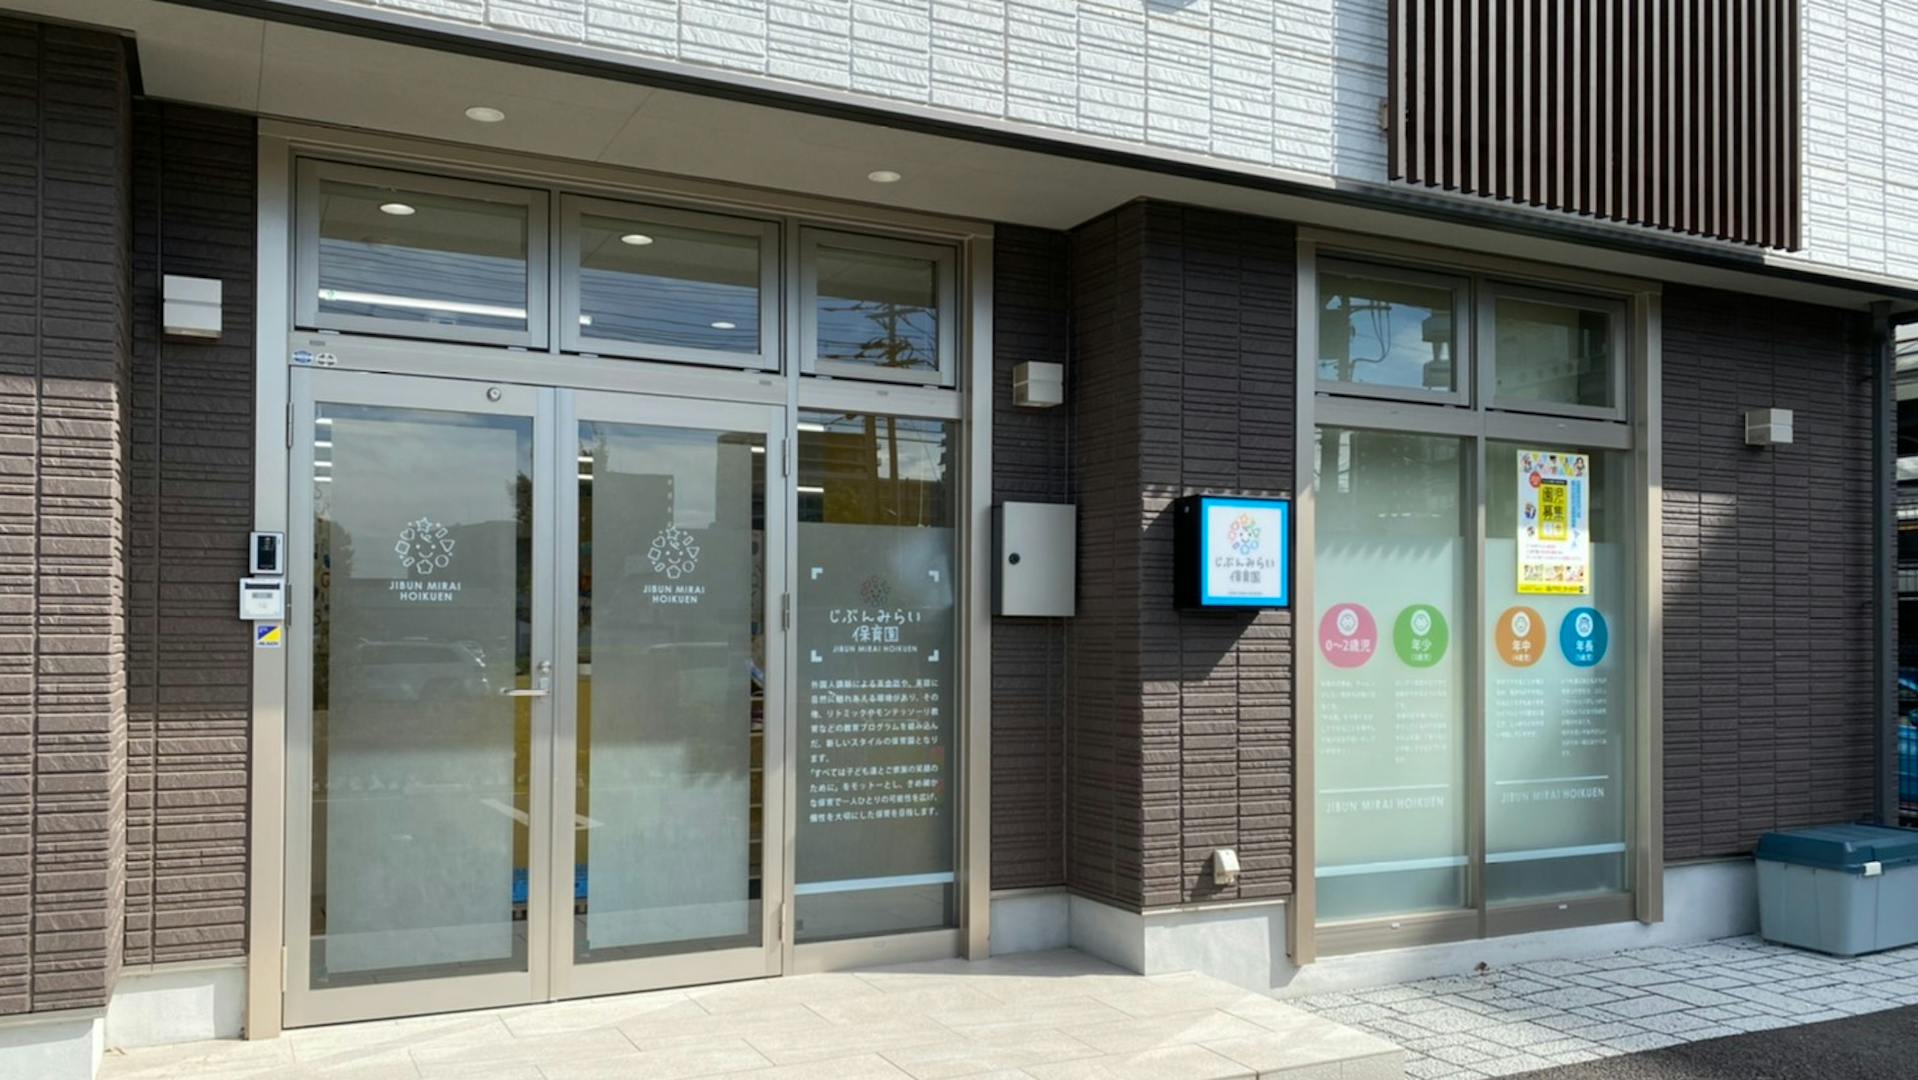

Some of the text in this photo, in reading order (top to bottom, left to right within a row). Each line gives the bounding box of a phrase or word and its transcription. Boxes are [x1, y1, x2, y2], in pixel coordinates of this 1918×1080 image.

[1215, 557, 1275, 570] じぶんみらい
[389, 581, 461, 591] JIBUN MIRAI
[643, 585, 705, 594] JIBUN MIRAI
[400, 591, 453, 601] HOIKUEN
[652, 595, 698, 604] HOIKUEN
[830, 608, 921, 625] じぶんみらい
[852, 624, 899, 642] 保育園
[883, 645, 918, 653] HOIKUEN
[1411, 638, 1432, 652] 年少
[1512, 639, 1532, 653] 年中
[1575, 639, 1594, 653] 年長
[1562, 787, 1604, 800] HOIKUEN
